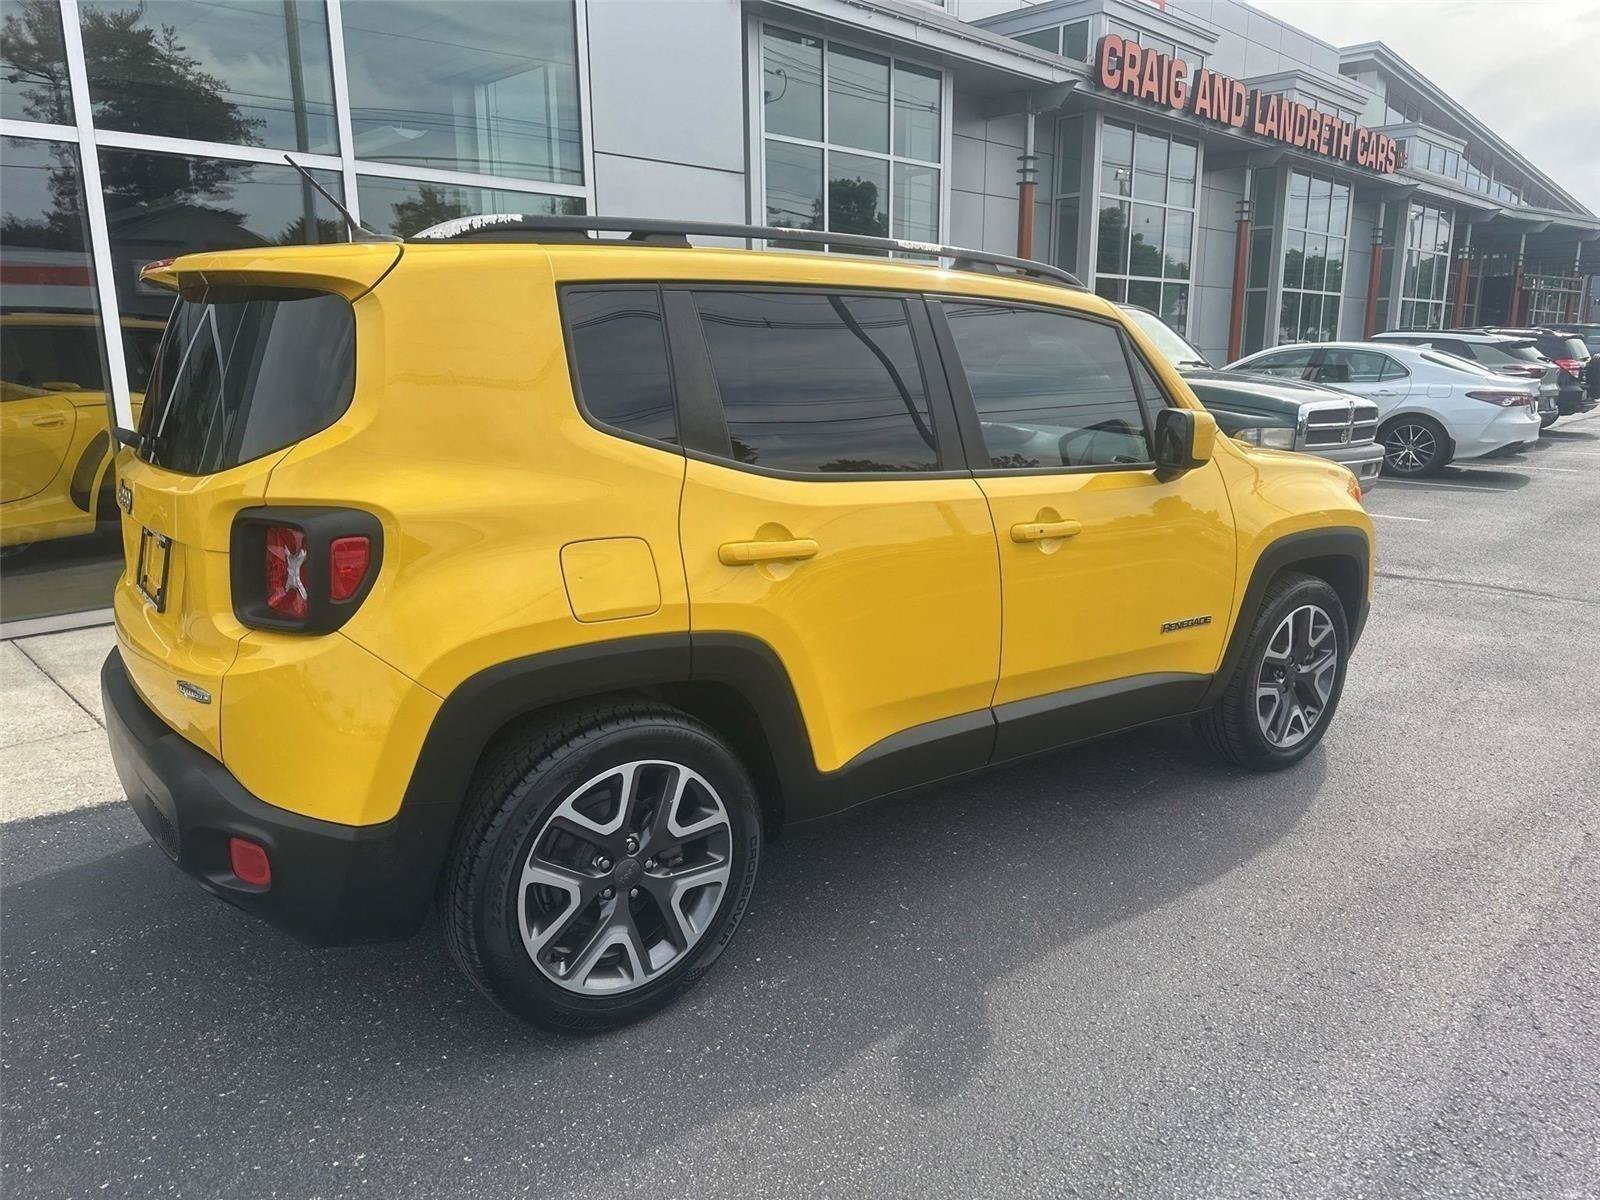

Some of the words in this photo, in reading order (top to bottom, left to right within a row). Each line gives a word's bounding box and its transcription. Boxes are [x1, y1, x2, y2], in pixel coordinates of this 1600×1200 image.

[1099, 34, 1188, 109] CRAIG
[1195, 68, 1247, 128] AND
[1252, 89, 1354, 161] LANDRETH
[1356, 127, 1397, 174] CARS
[1160, 614, 1212, 634] RENEGADE
